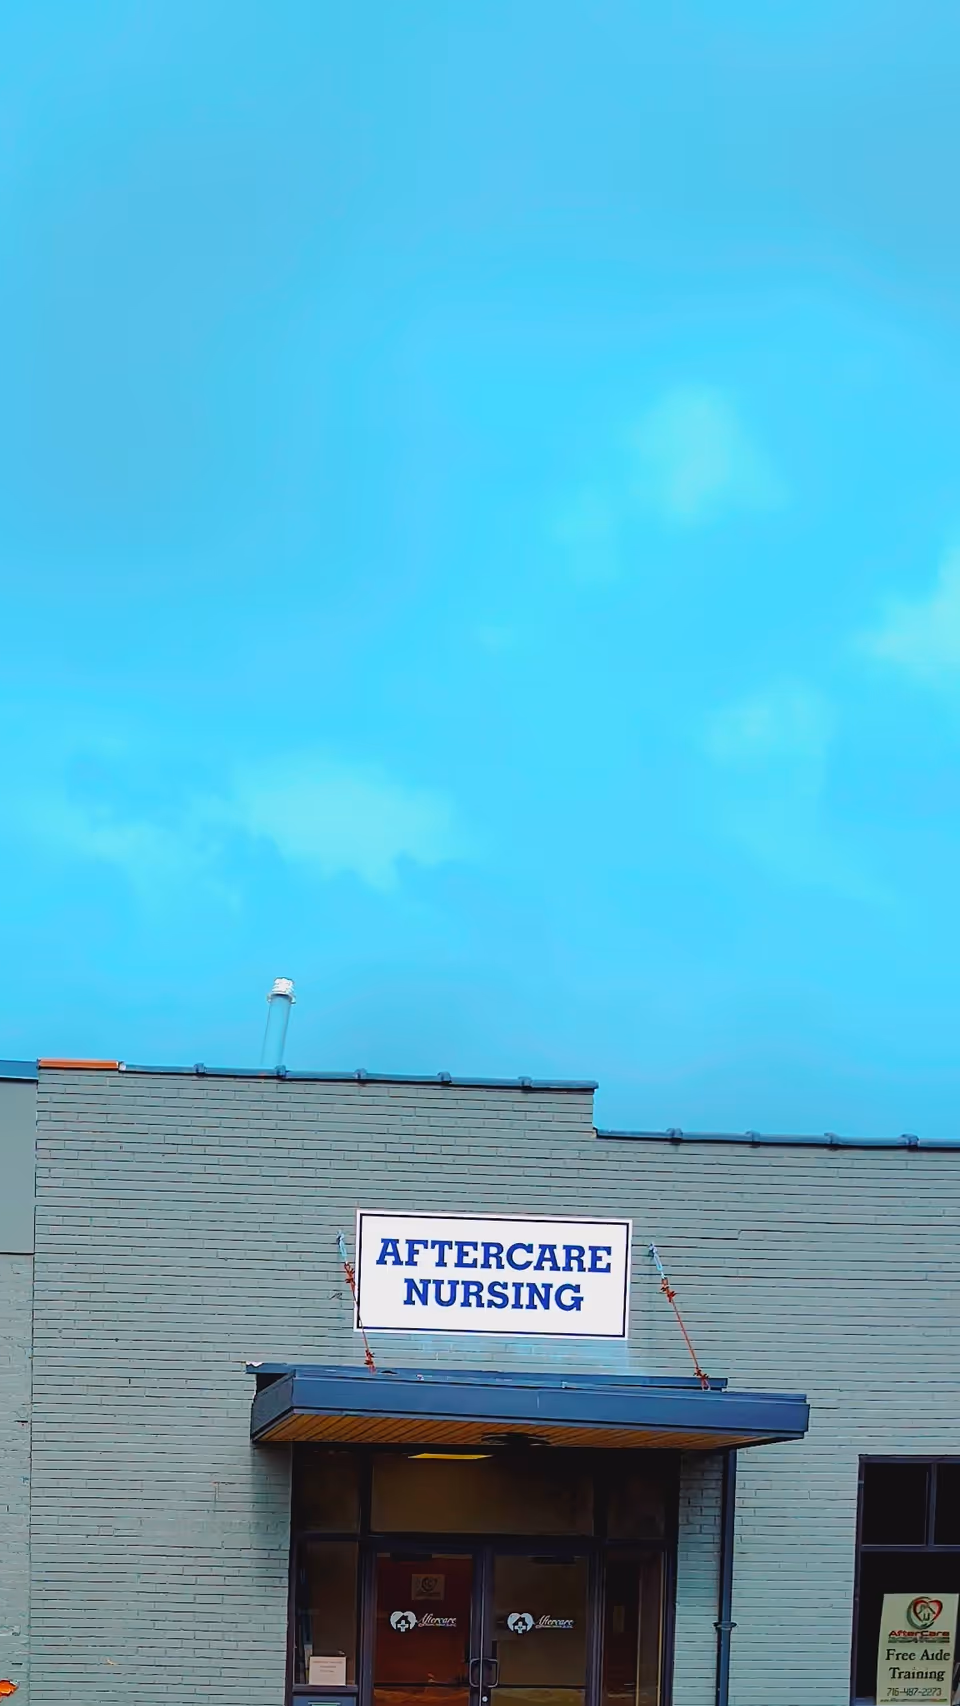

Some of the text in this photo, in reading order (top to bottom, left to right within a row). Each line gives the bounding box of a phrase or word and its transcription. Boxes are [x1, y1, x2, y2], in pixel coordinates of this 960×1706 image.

[375, 1237, 612, 1273] AFTERCARE
[403, 1277, 584, 1311] NURSING
[885, 1648, 951, 1661] Free Aide
[889, 1666, 946, 1682] Training
